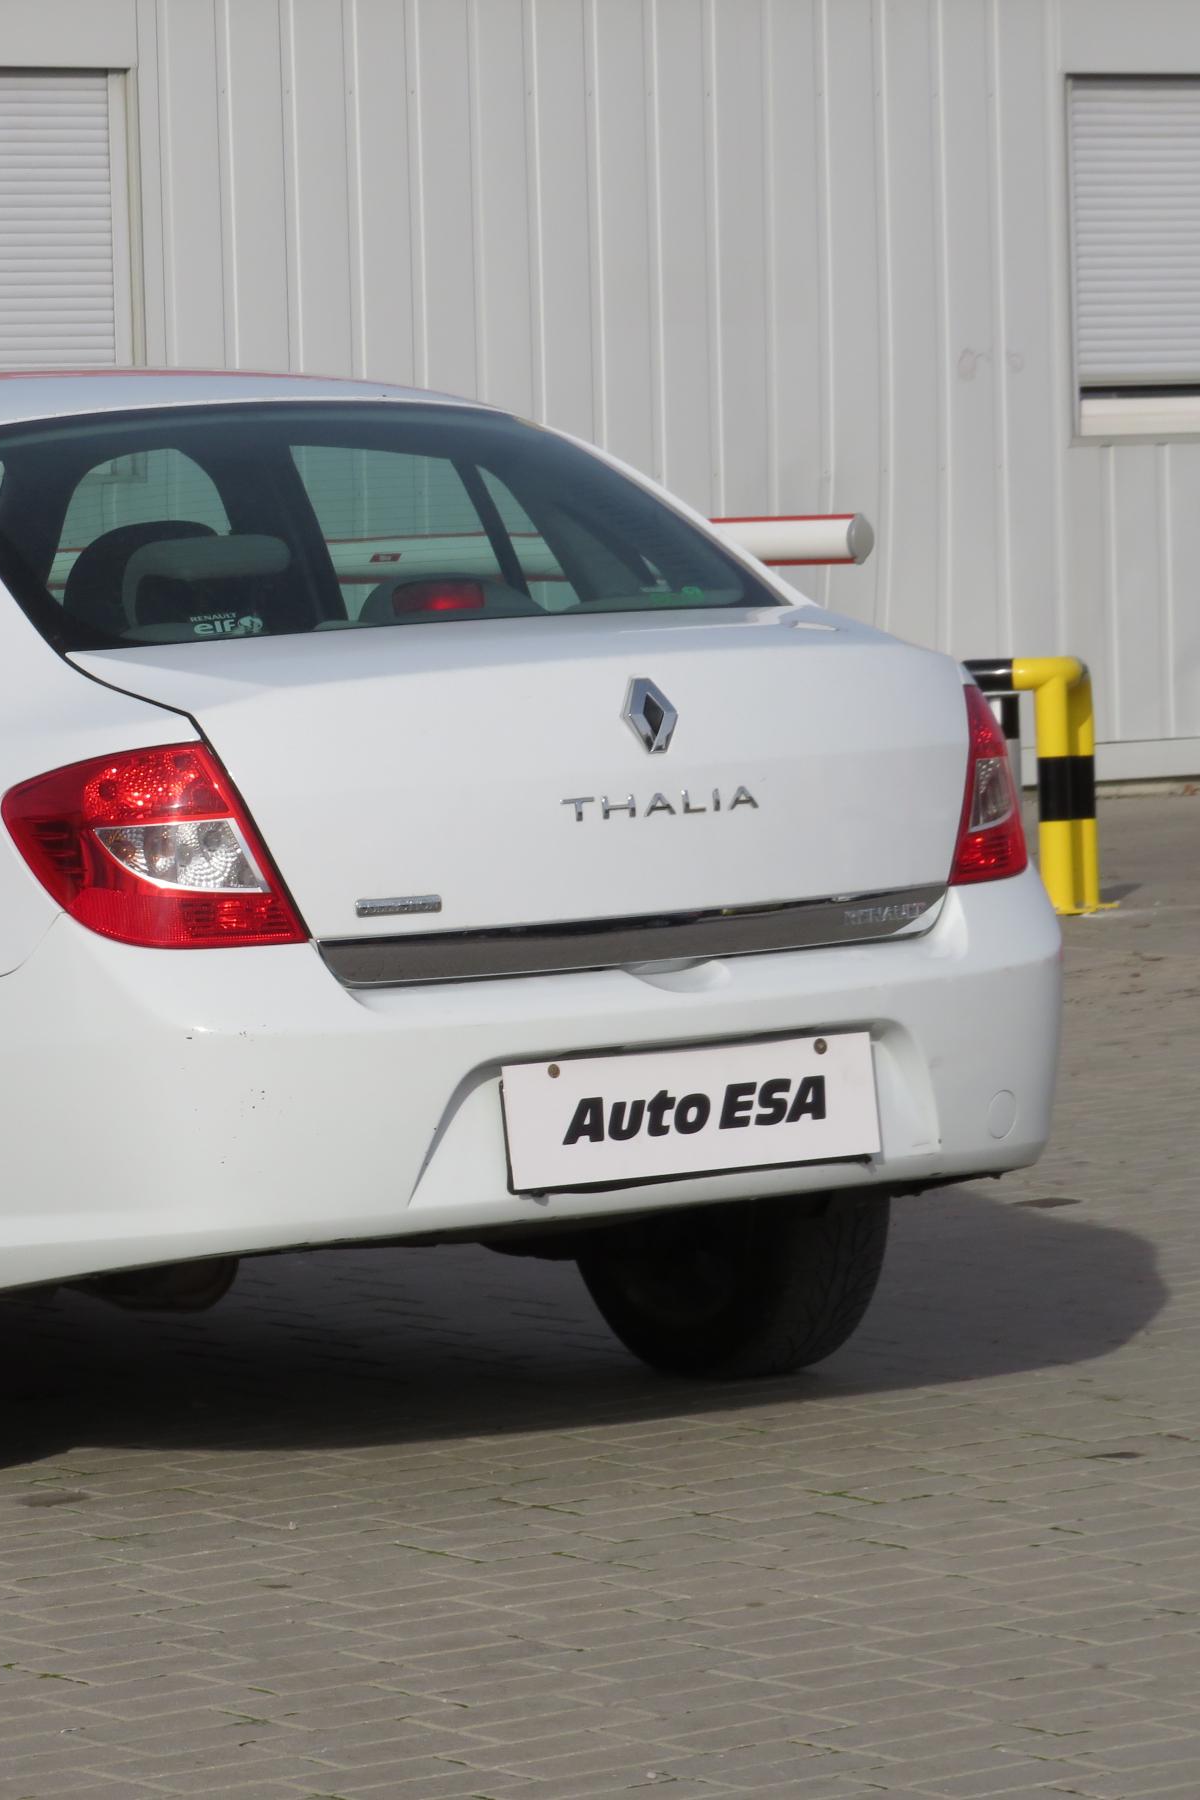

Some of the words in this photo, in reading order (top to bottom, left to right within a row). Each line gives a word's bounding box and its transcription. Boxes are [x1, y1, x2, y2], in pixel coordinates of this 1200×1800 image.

[190, 612, 237, 622] RENAULT
[560, 786, 759, 822] THALIA
[562, 1089, 711, 1146] Auto
[718, 1075, 827, 1130] ESA
